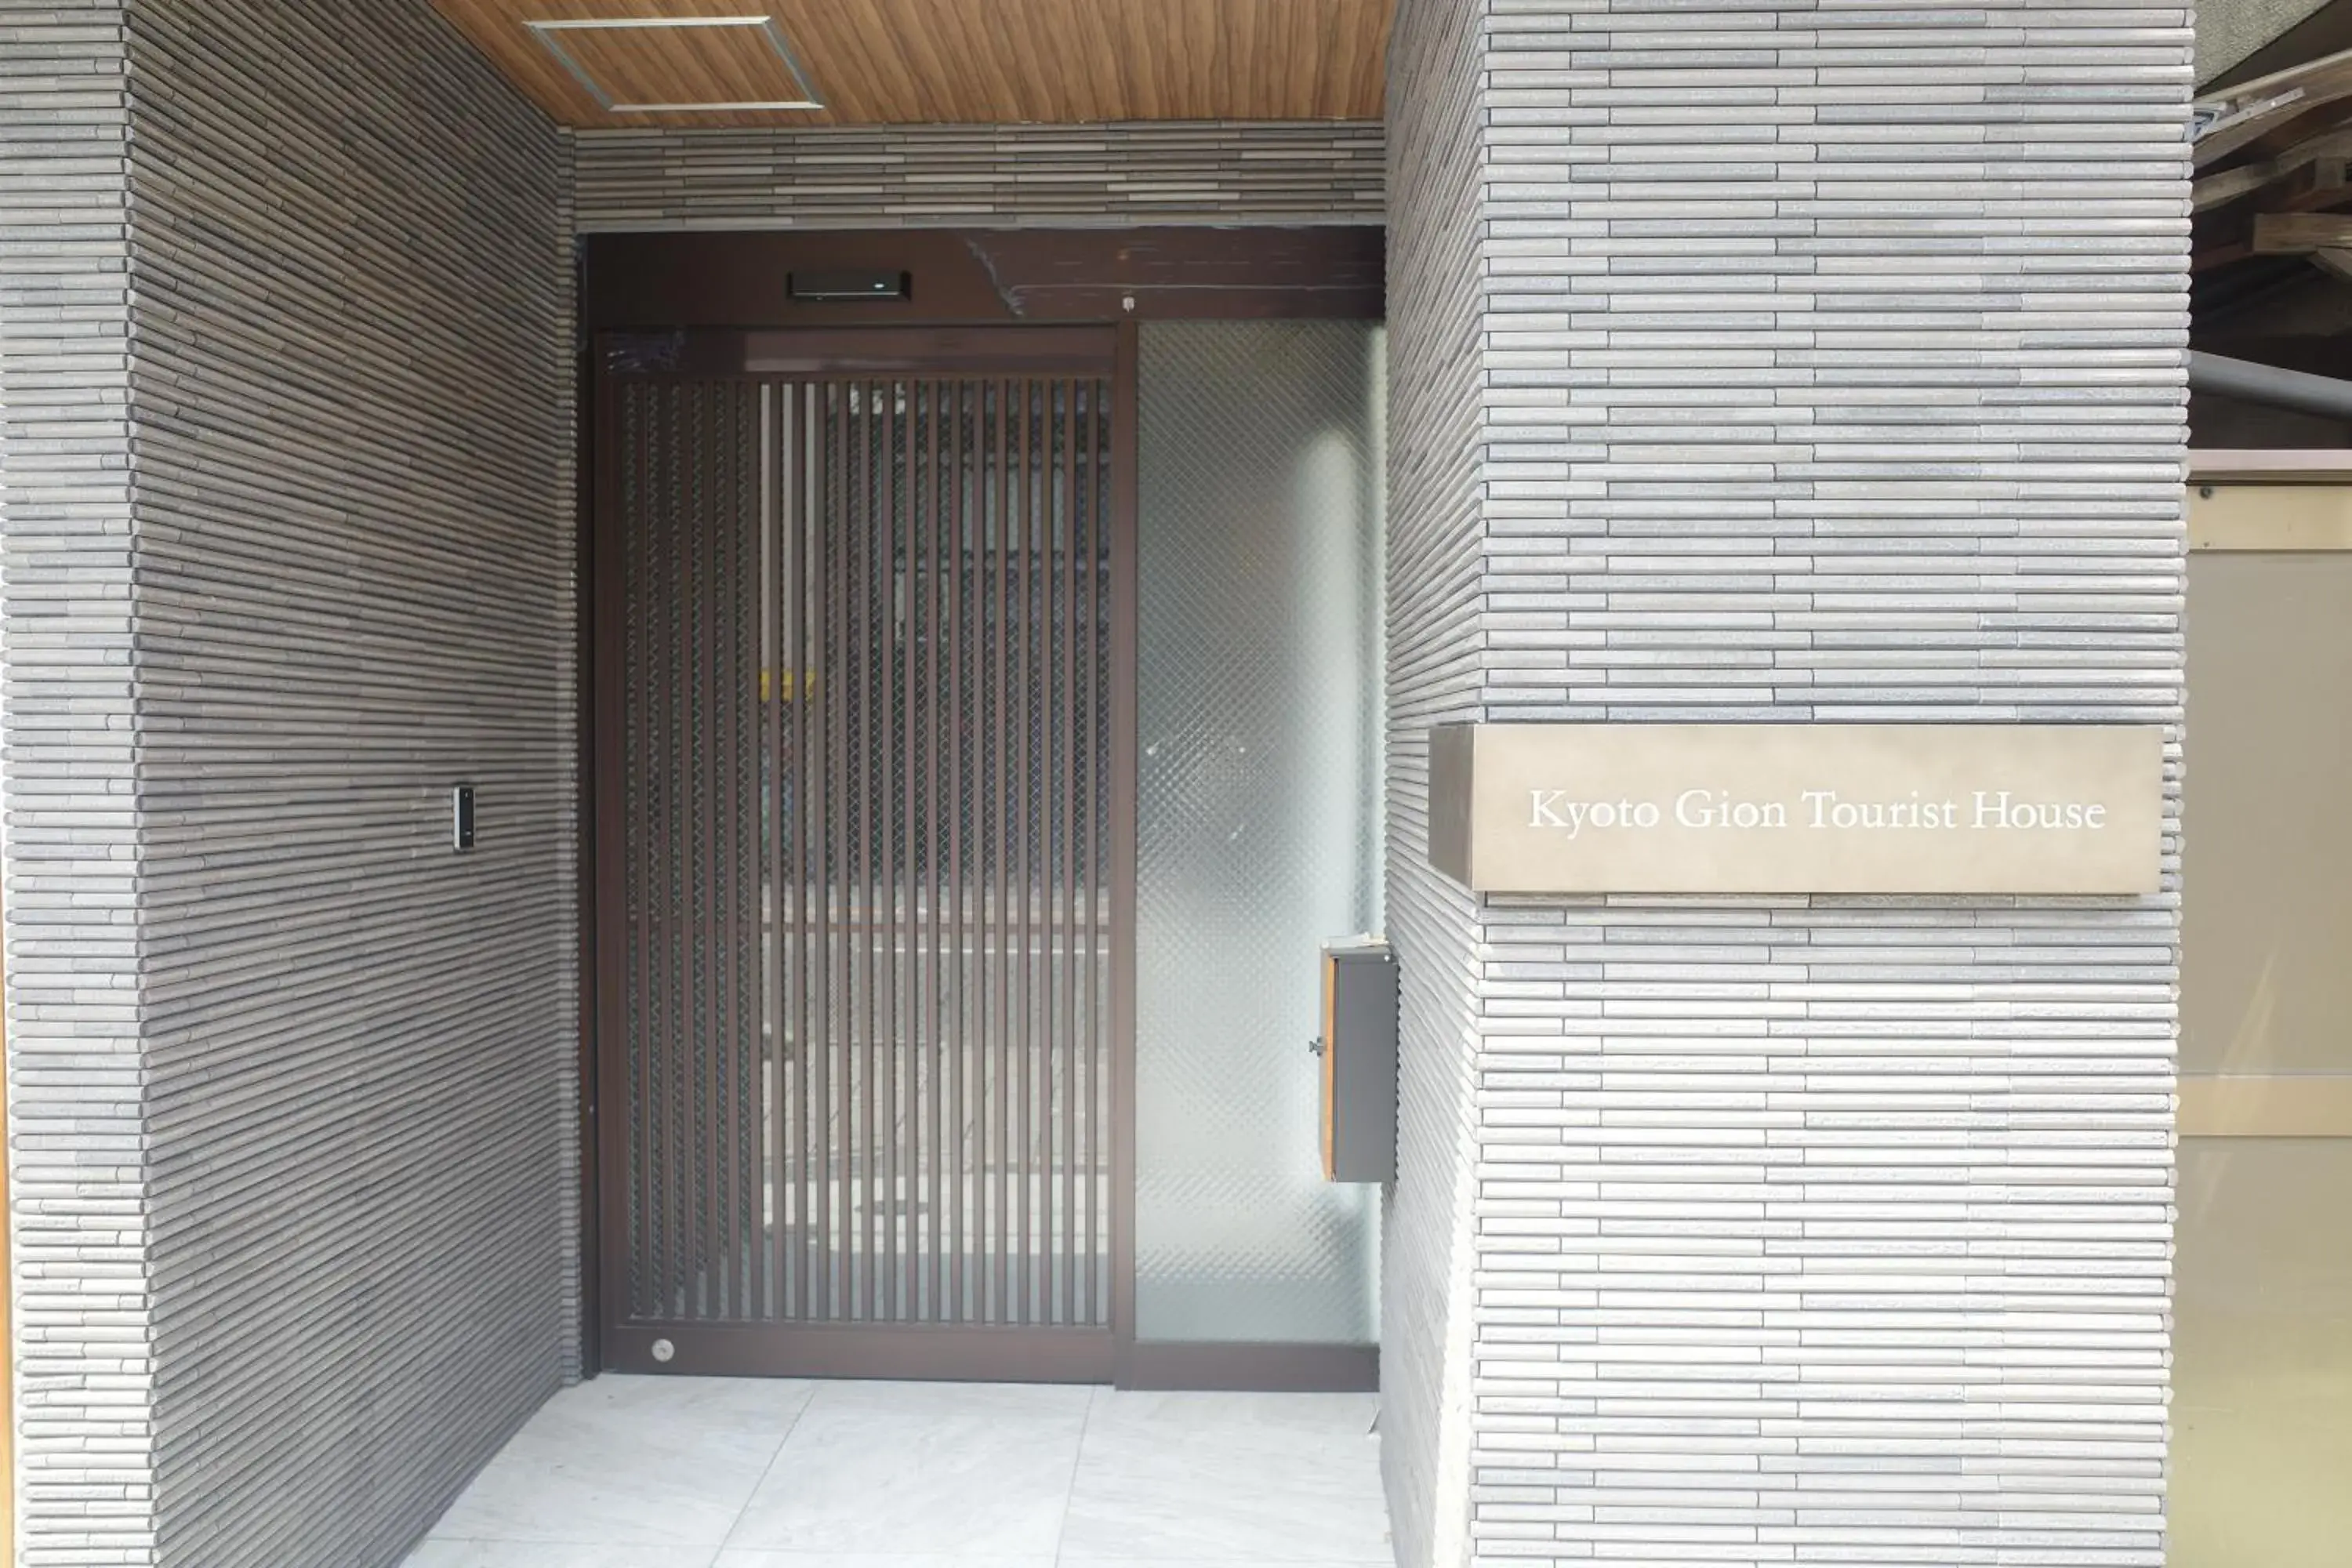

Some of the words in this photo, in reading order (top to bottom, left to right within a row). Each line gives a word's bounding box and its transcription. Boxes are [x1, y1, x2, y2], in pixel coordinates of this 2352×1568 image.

[1528, 789, 1661, 840] Kyoto
[1675, 789, 1788, 828] Gion
[1800, 789, 1959, 829] Tourist
[1970, 790, 2107, 829] House
